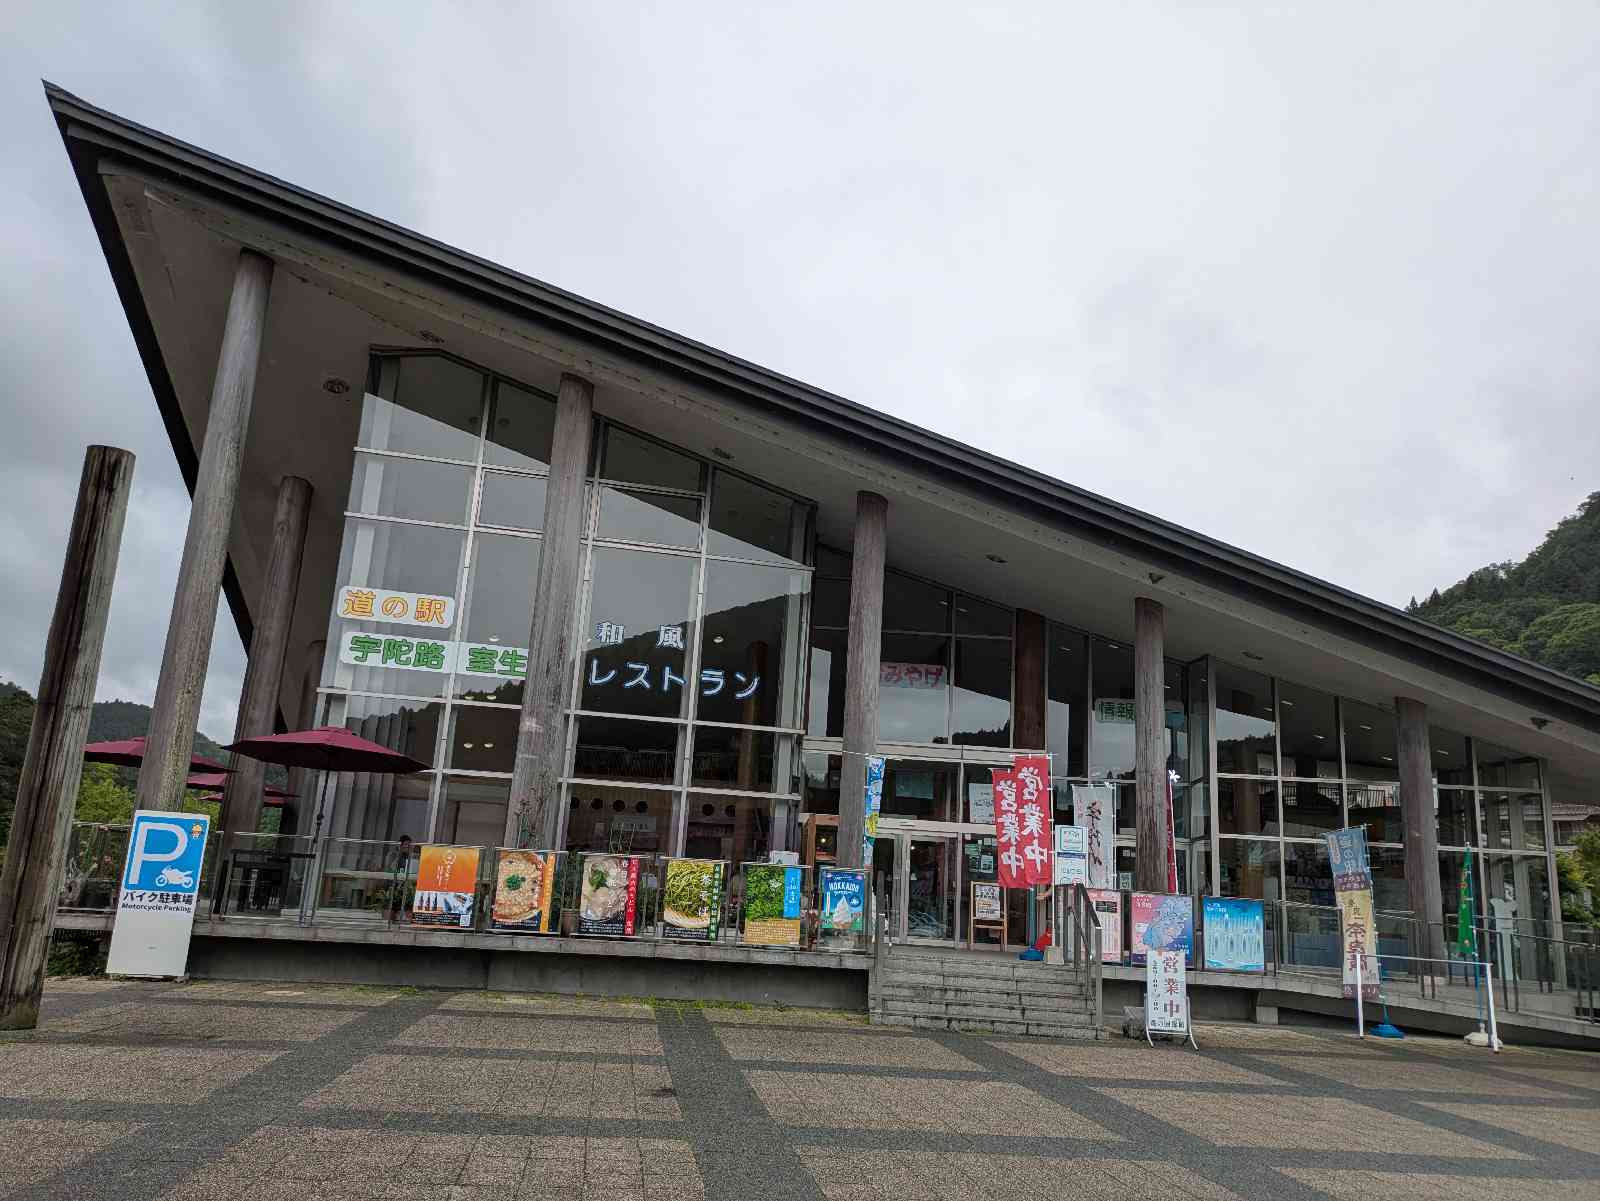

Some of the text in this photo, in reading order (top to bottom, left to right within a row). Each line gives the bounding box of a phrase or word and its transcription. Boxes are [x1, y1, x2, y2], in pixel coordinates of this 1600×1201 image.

[343, 590, 448, 625] 道の駅
[349, 635, 529, 677] 宇陀路 室生
[597, 621, 687, 651] 和風
[587, 657, 762, 700] レストラン
[997, 778, 1025, 879] 営業中
[1017, 765, 1048, 873] 営業中
[128, 822, 188, 885] P
[122, 891, 194, 906] バイク駐車場
[122, 903, 192, 914] Motorcycle Parking
[1164, 955, 1180, 1017] 営業中
